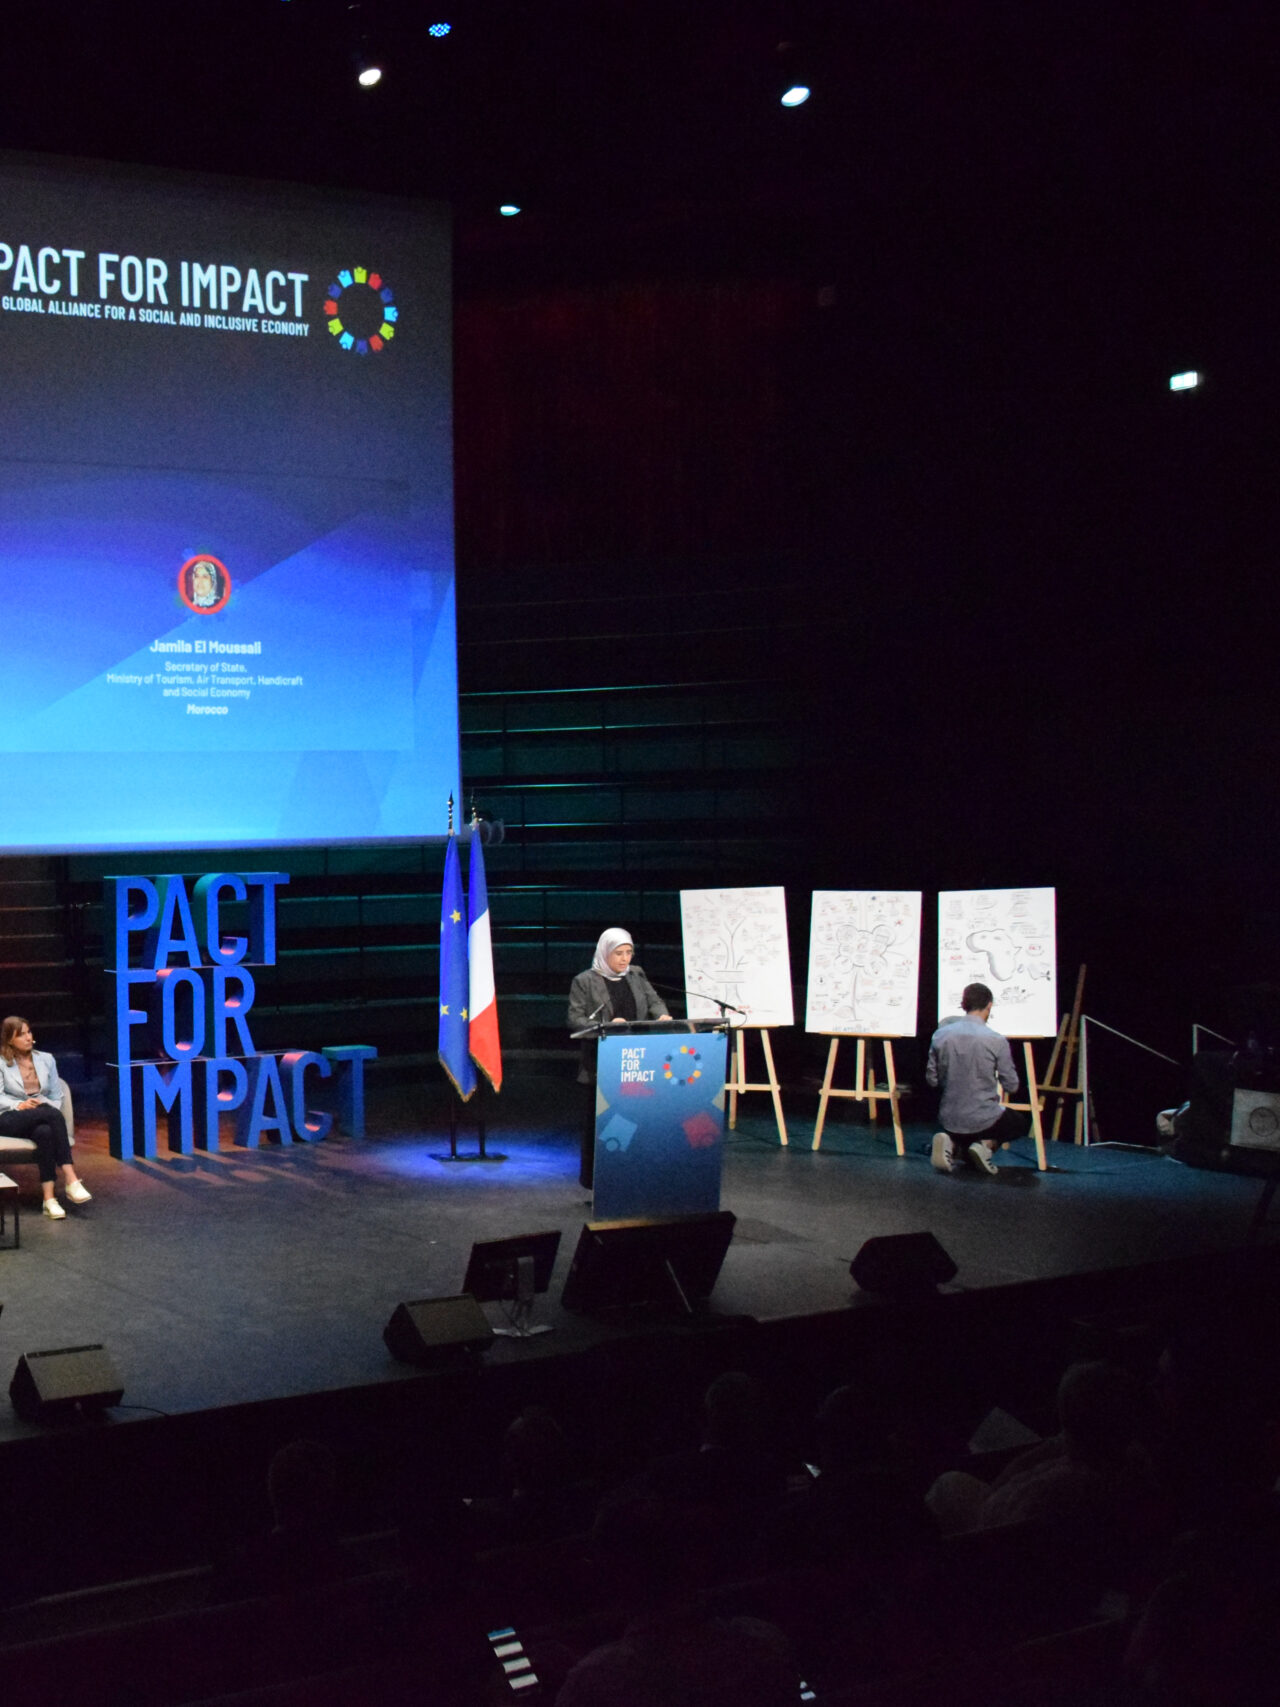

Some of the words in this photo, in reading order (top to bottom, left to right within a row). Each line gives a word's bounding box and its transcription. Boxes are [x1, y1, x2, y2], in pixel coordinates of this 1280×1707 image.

[98, 252, 169, 305] FOR
[180, 261, 309, 317] IMPACT
[2, 295, 45, 314] GLOBAL
[48, 300, 102, 319] ALLIANCE
[104, 304, 126, 321] FOR
[128, 307, 136, 321] A
[139, 307, 177, 326] SOCIAL
[179, 311, 201, 328] AND
[204, 314, 259, 333] INCLUSIVE
[261, 319, 310, 337] ECONOMY
[150, 639, 192, 653] Jamila
[194, 640, 206, 654] El
[208, 640, 262, 655] Moussali
[164, 661, 208, 674] Secretary
[209, 662, 220, 673] of
[106, 673, 142, 687] Ministry
[144, 674, 154, 684] of
[196, 674, 209, 685] Air
[258, 675, 304, 686] Handicraft
[163, 688, 180, 697] and
[181, 687, 209, 697] Social
[210, 687, 251, 700] Economy
[186, 703, 229, 715] Morocco
[114, 872, 289, 971] PACT
[116, 964, 256, 1065] FOR
[621, 1047, 646, 1060] PACT
[621, 1059, 640, 1071] FOR
[621, 1070, 656, 1083] IMPACT
[117, 1045, 378, 1160] IMPACT
